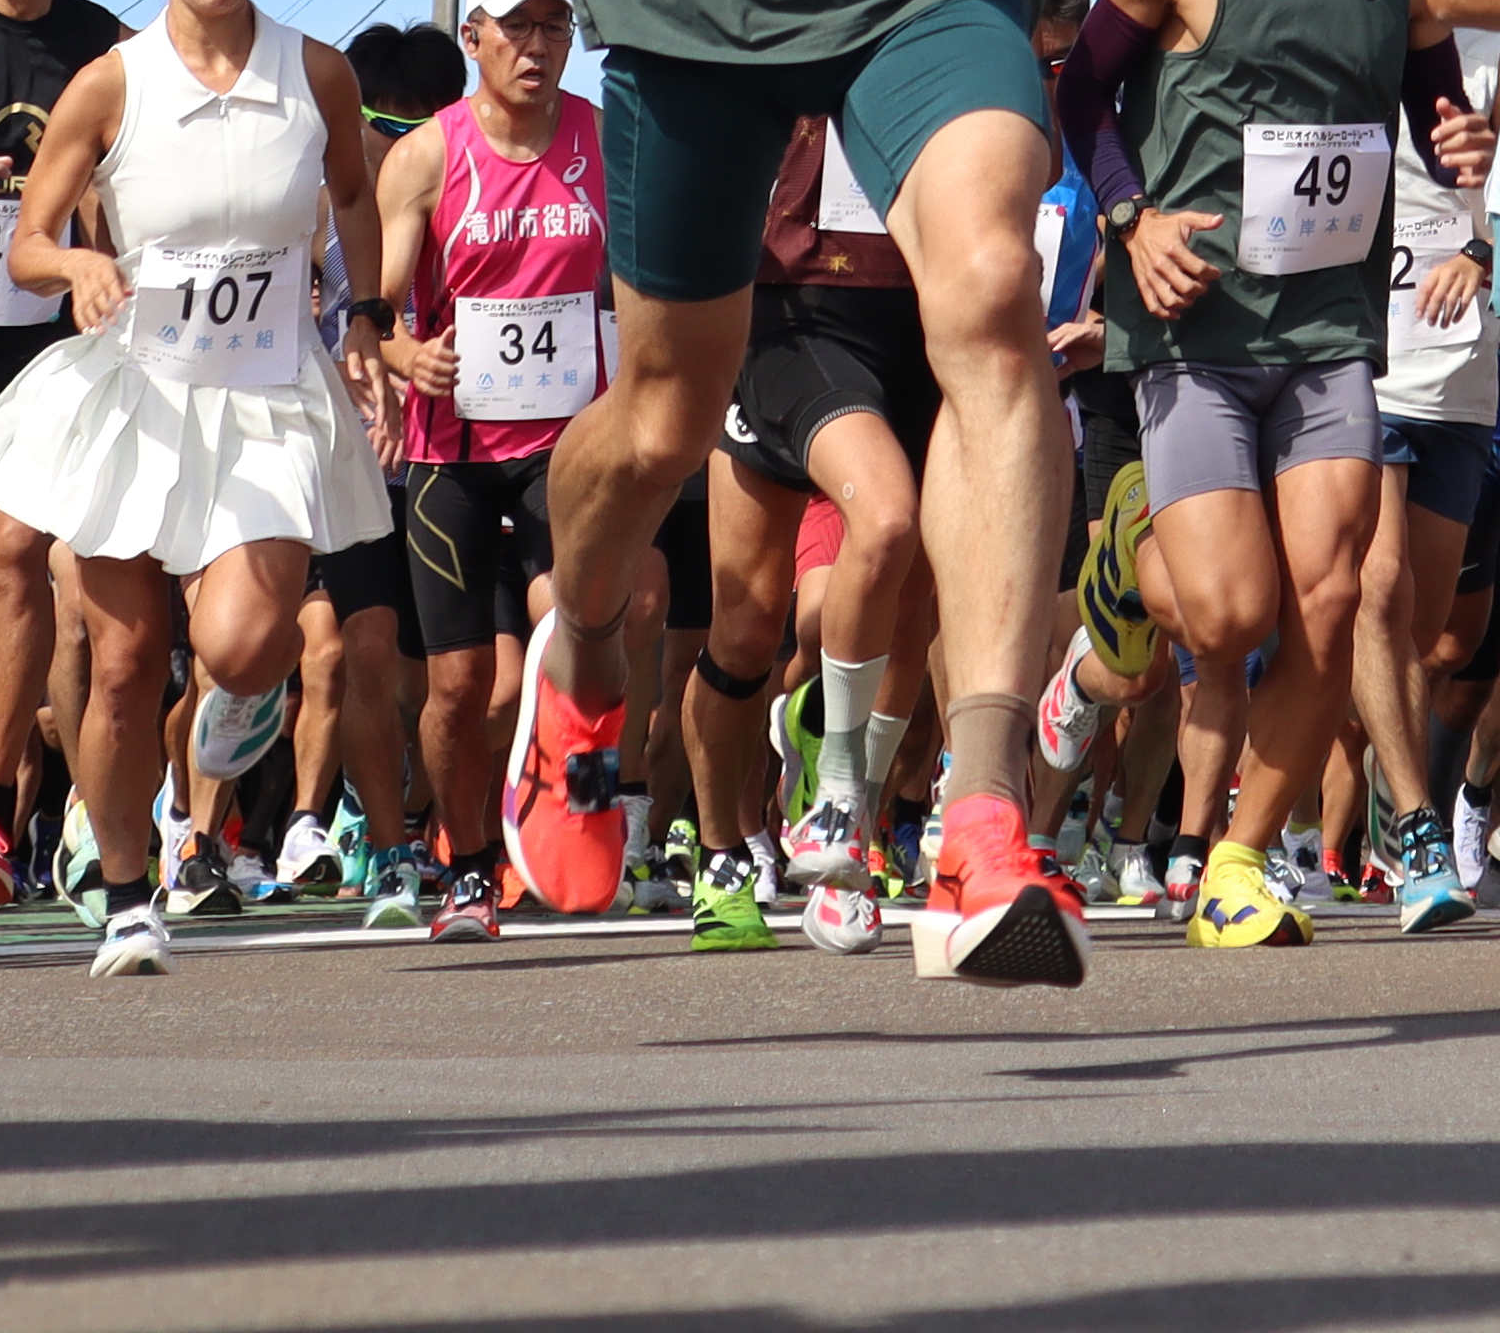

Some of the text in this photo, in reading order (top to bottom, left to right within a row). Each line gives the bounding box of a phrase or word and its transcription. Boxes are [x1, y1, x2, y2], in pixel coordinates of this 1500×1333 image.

[1294, 154, 1353, 207] 49
[464, 202, 591, 246] 滝川市役所
[175, 271, 273, 326] 107
[499, 320, 557, 365] 34
